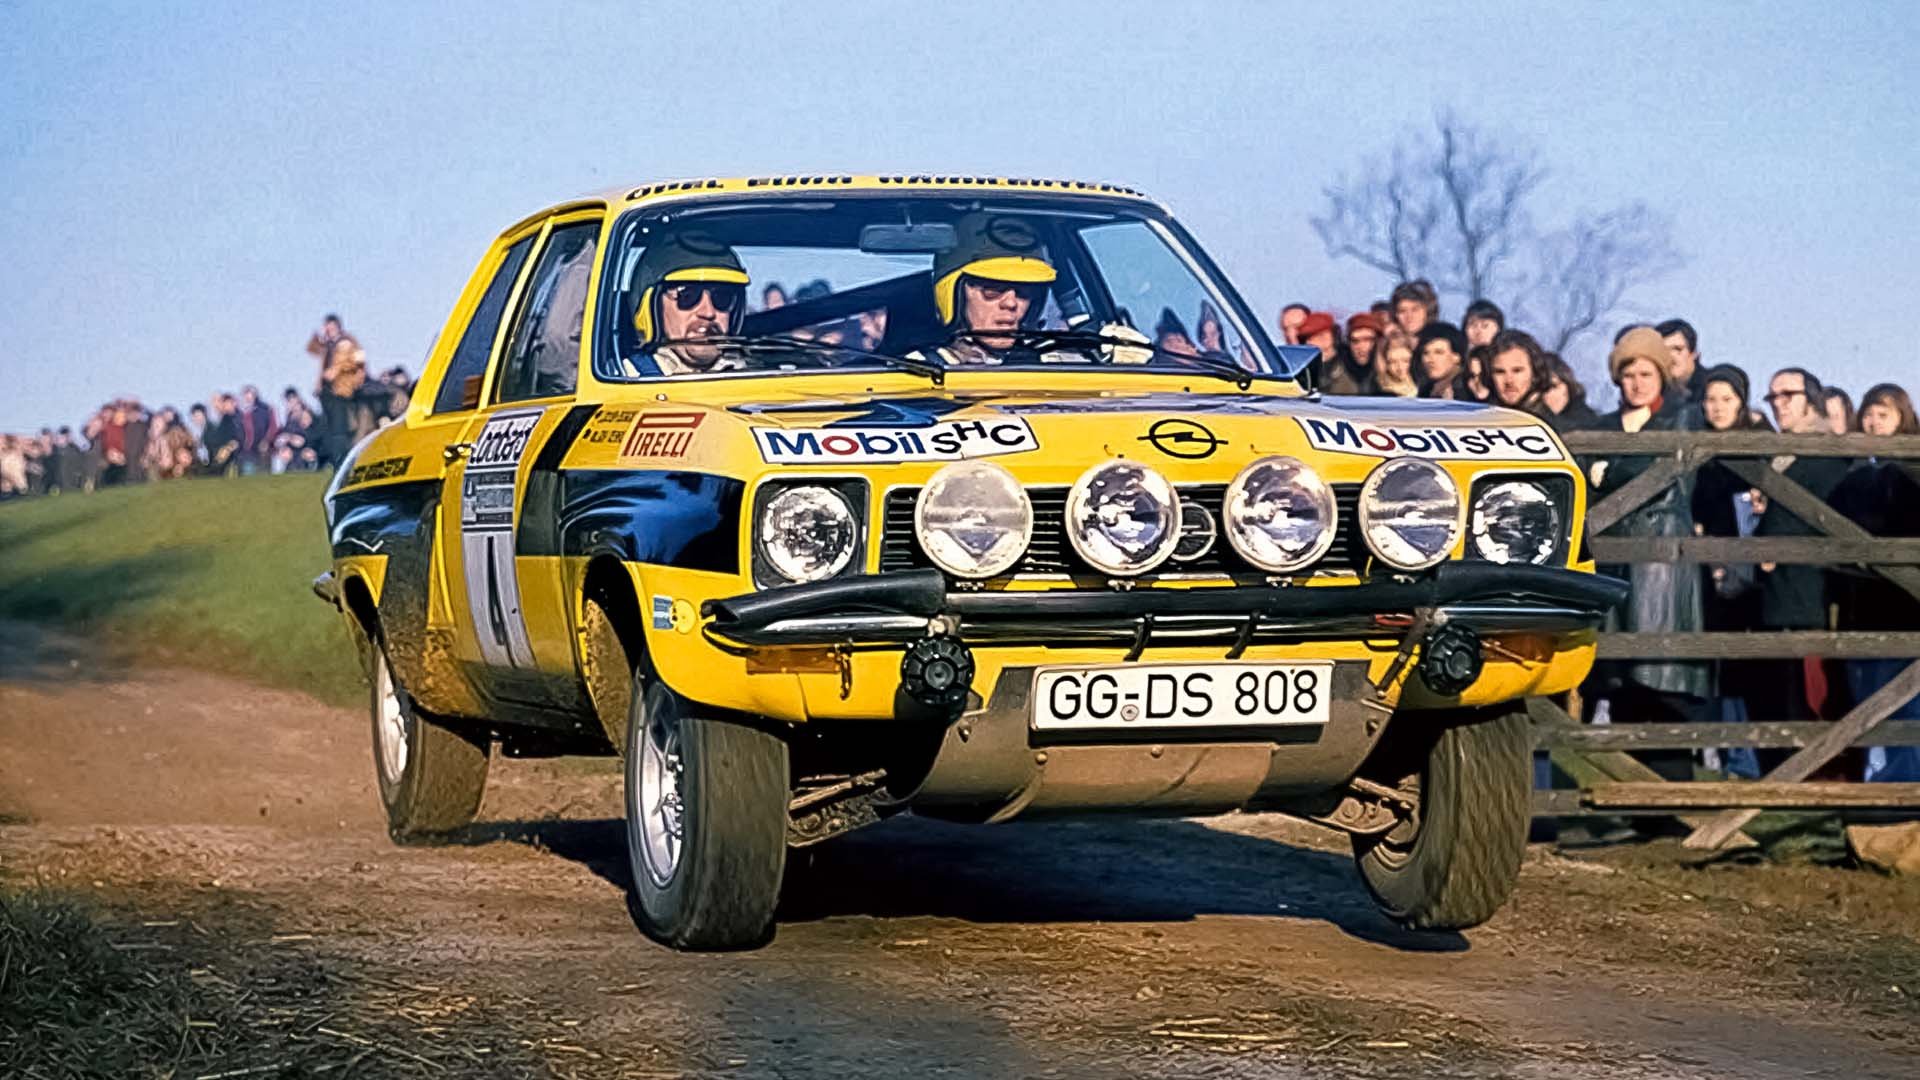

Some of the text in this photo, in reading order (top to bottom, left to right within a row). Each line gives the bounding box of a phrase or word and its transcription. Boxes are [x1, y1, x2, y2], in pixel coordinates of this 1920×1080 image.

[621, 411, 706, 458] PIRELLI
[764, 420, 1026, 456] Mobil SHC
[1306, 418, 1550, 455] Mobil SHC
[1049, 669, 1318, 721] GG-DS 808
